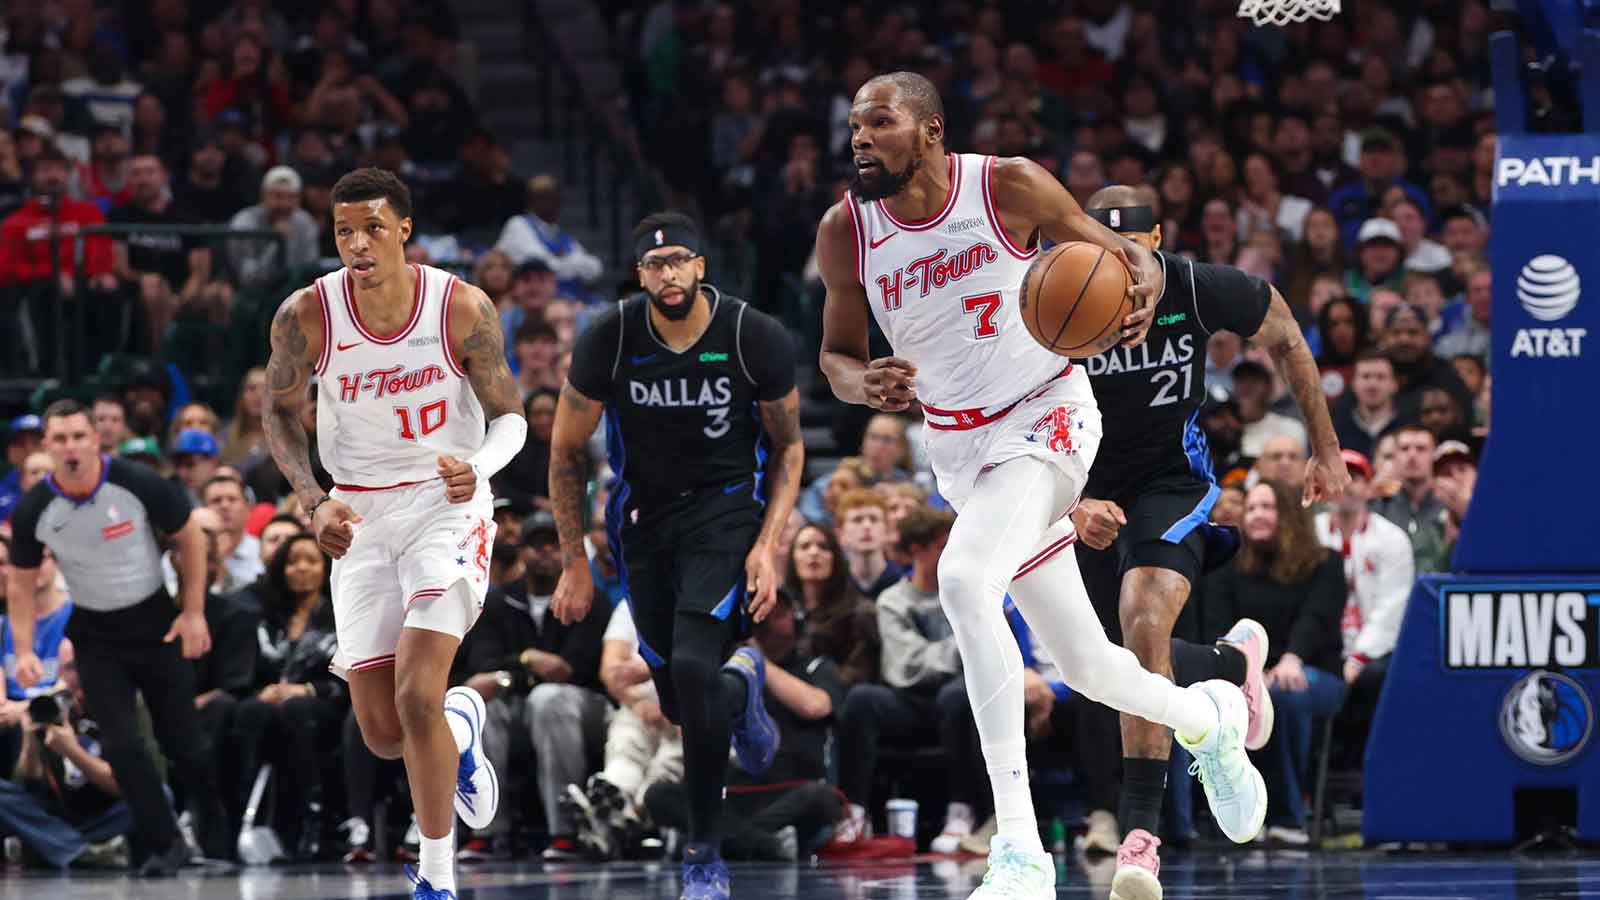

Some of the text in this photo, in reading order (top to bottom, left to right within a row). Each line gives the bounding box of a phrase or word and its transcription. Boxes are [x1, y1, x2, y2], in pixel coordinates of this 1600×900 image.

[876, 242, 998, 312] H-Town
[961, 290, 1003, 340] 7
[1087, 333, 1194, 376] DALLAS
[1510, 328, 1587, 357] AT&T
[337, 364, 447, 403] H-Town
[629, 376, 732, 406] DALLAS
[1149, 362, 1193, 407] 21
[392, 398, 448, 441] 10
[704, 407, 731, 438] 3
[1448, 592, 1586, 667] MAVS
